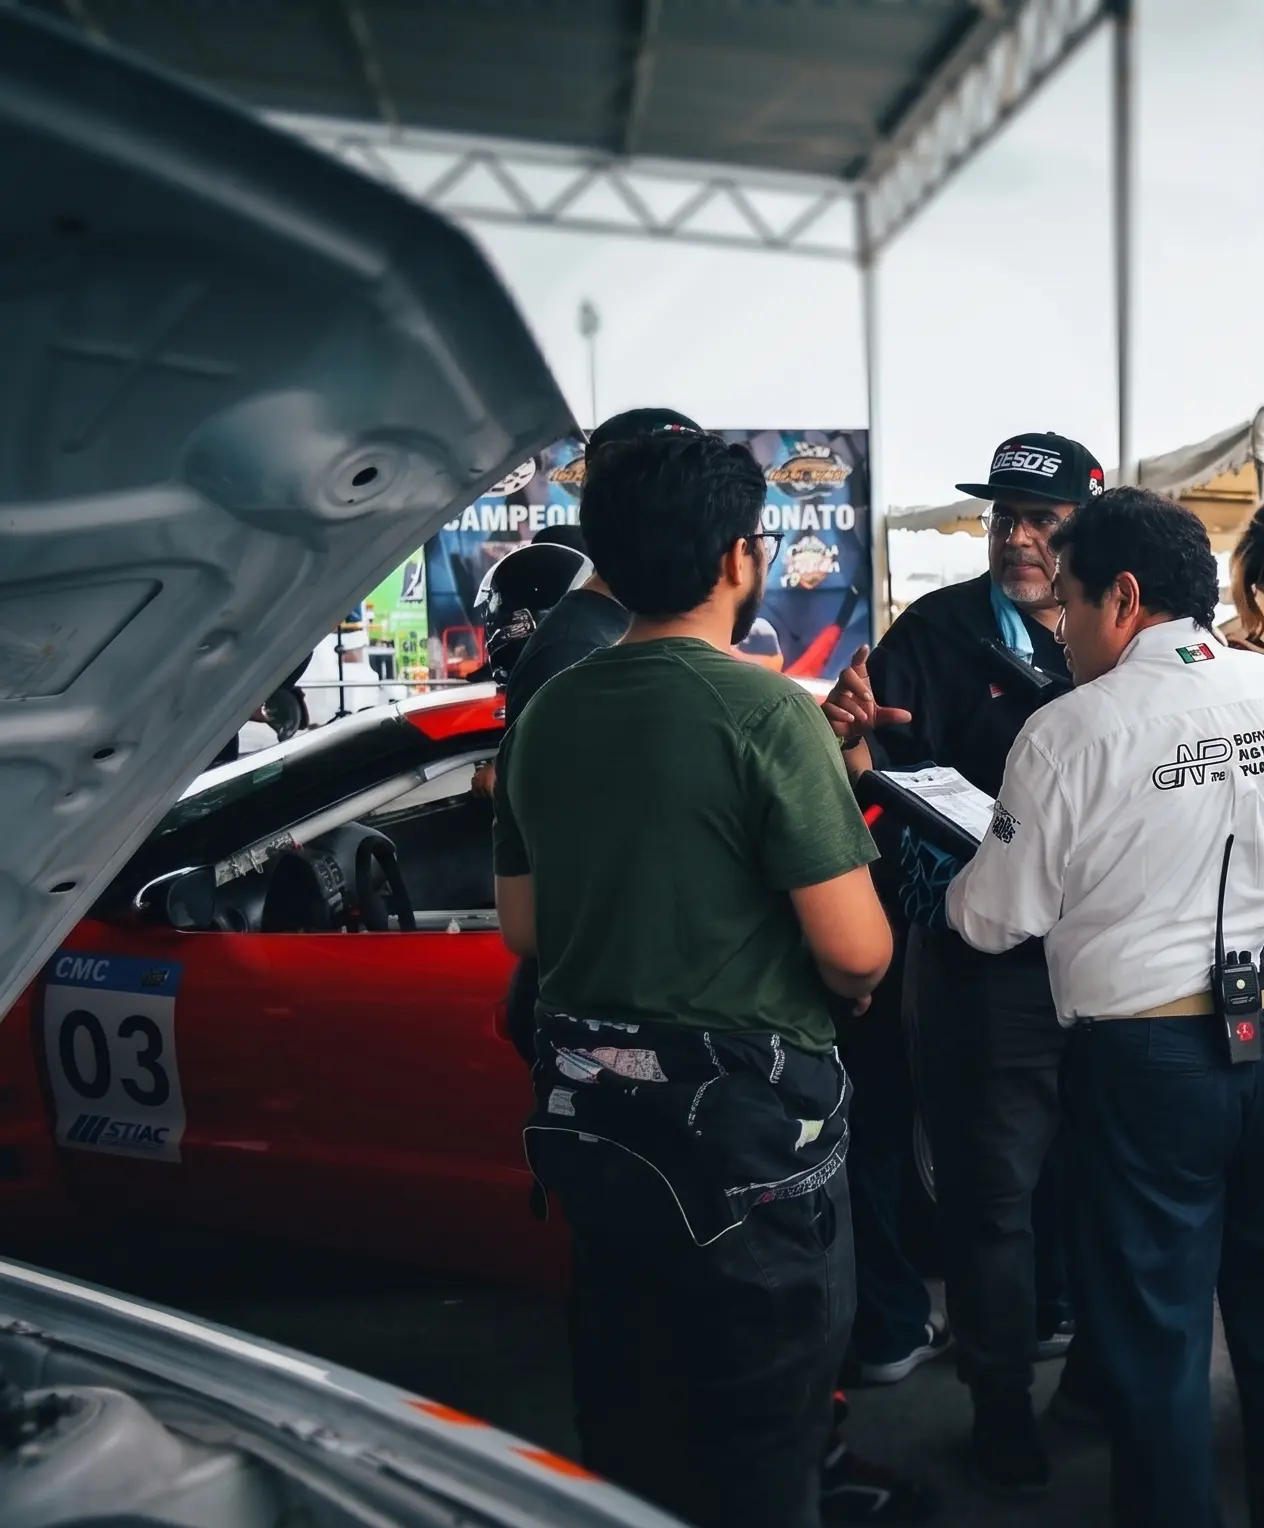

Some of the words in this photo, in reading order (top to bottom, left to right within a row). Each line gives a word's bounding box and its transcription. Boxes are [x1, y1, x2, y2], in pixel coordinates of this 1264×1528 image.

[55, 956, 110, 982] CMC
[59, 1009, 170, 1107] 03
[104, 1121, 170, 1144] STIAC
